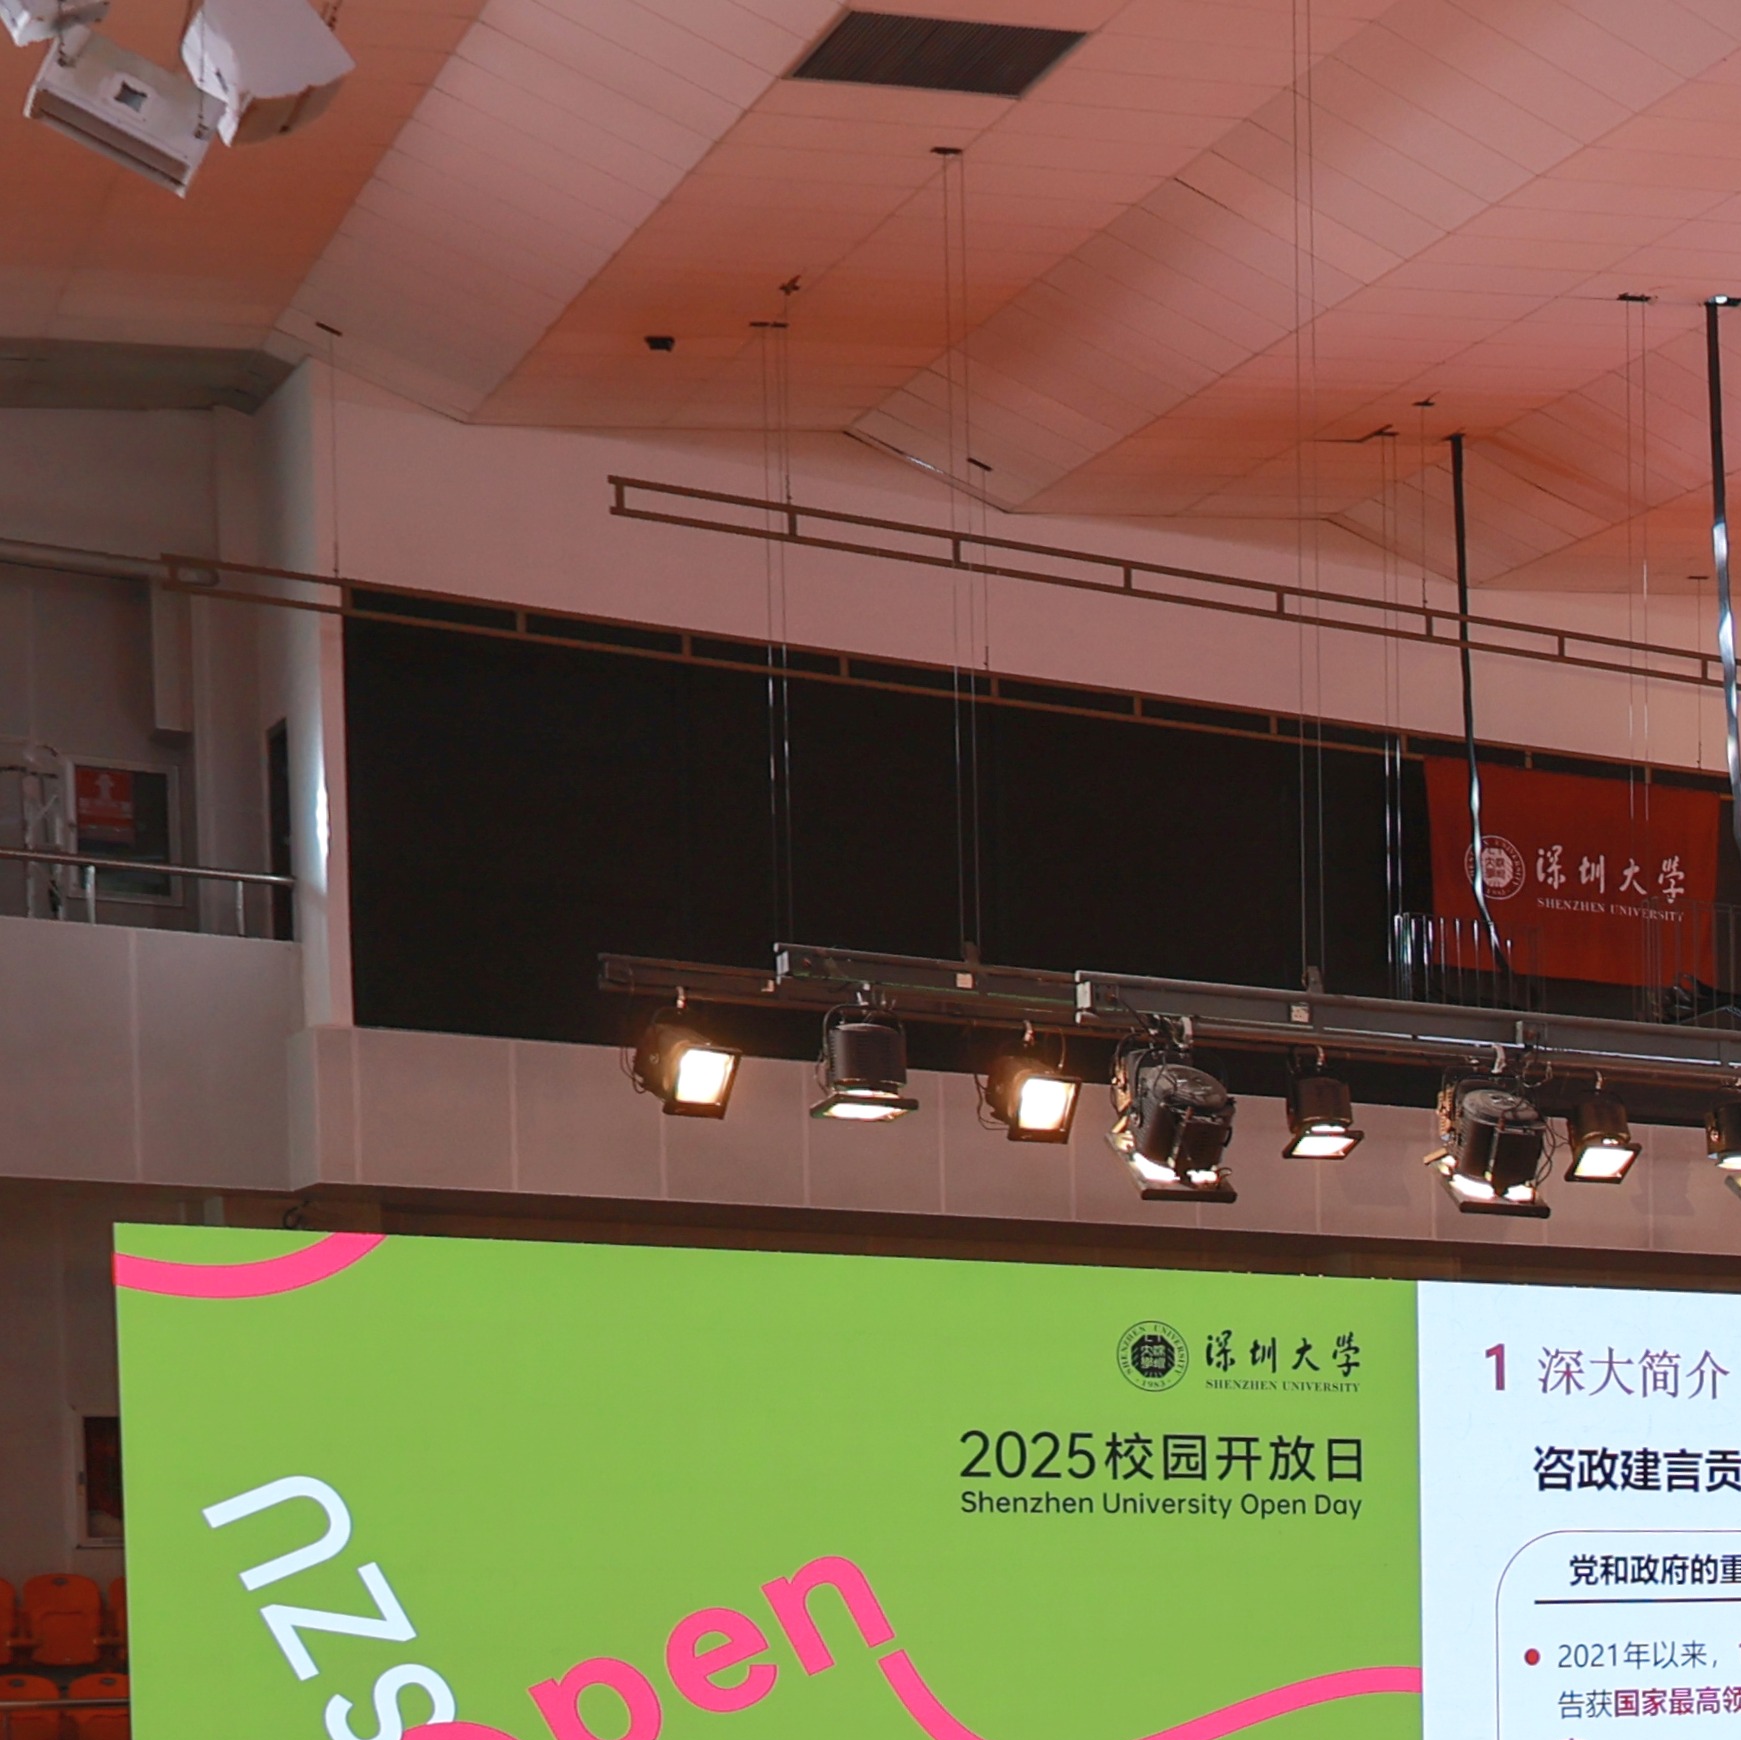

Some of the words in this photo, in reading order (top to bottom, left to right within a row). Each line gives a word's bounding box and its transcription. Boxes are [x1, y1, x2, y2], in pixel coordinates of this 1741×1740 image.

[1537, 898, 1605, 913] SHENZHEN
[1610, 905, 1684, 922] UNIVERSITY
[1205, 1379, 1278, 1392] SHENZHEN
[1282, 1381, 1361, 1394] UNIVERSITY
[1484, 1343, 1507, 1392] 1
[1537, 1344, 1732, 1401] 深大简介
[960, 1429, 1363, 1484] 2025校园开放日
[960, 1490, 1094, 1515] Shenzhen
[1102, 1492, 1233, 1520] University
[1240, 1493, 1307, 1520] Open
[1315, 1494, 1363, 1521] Day
